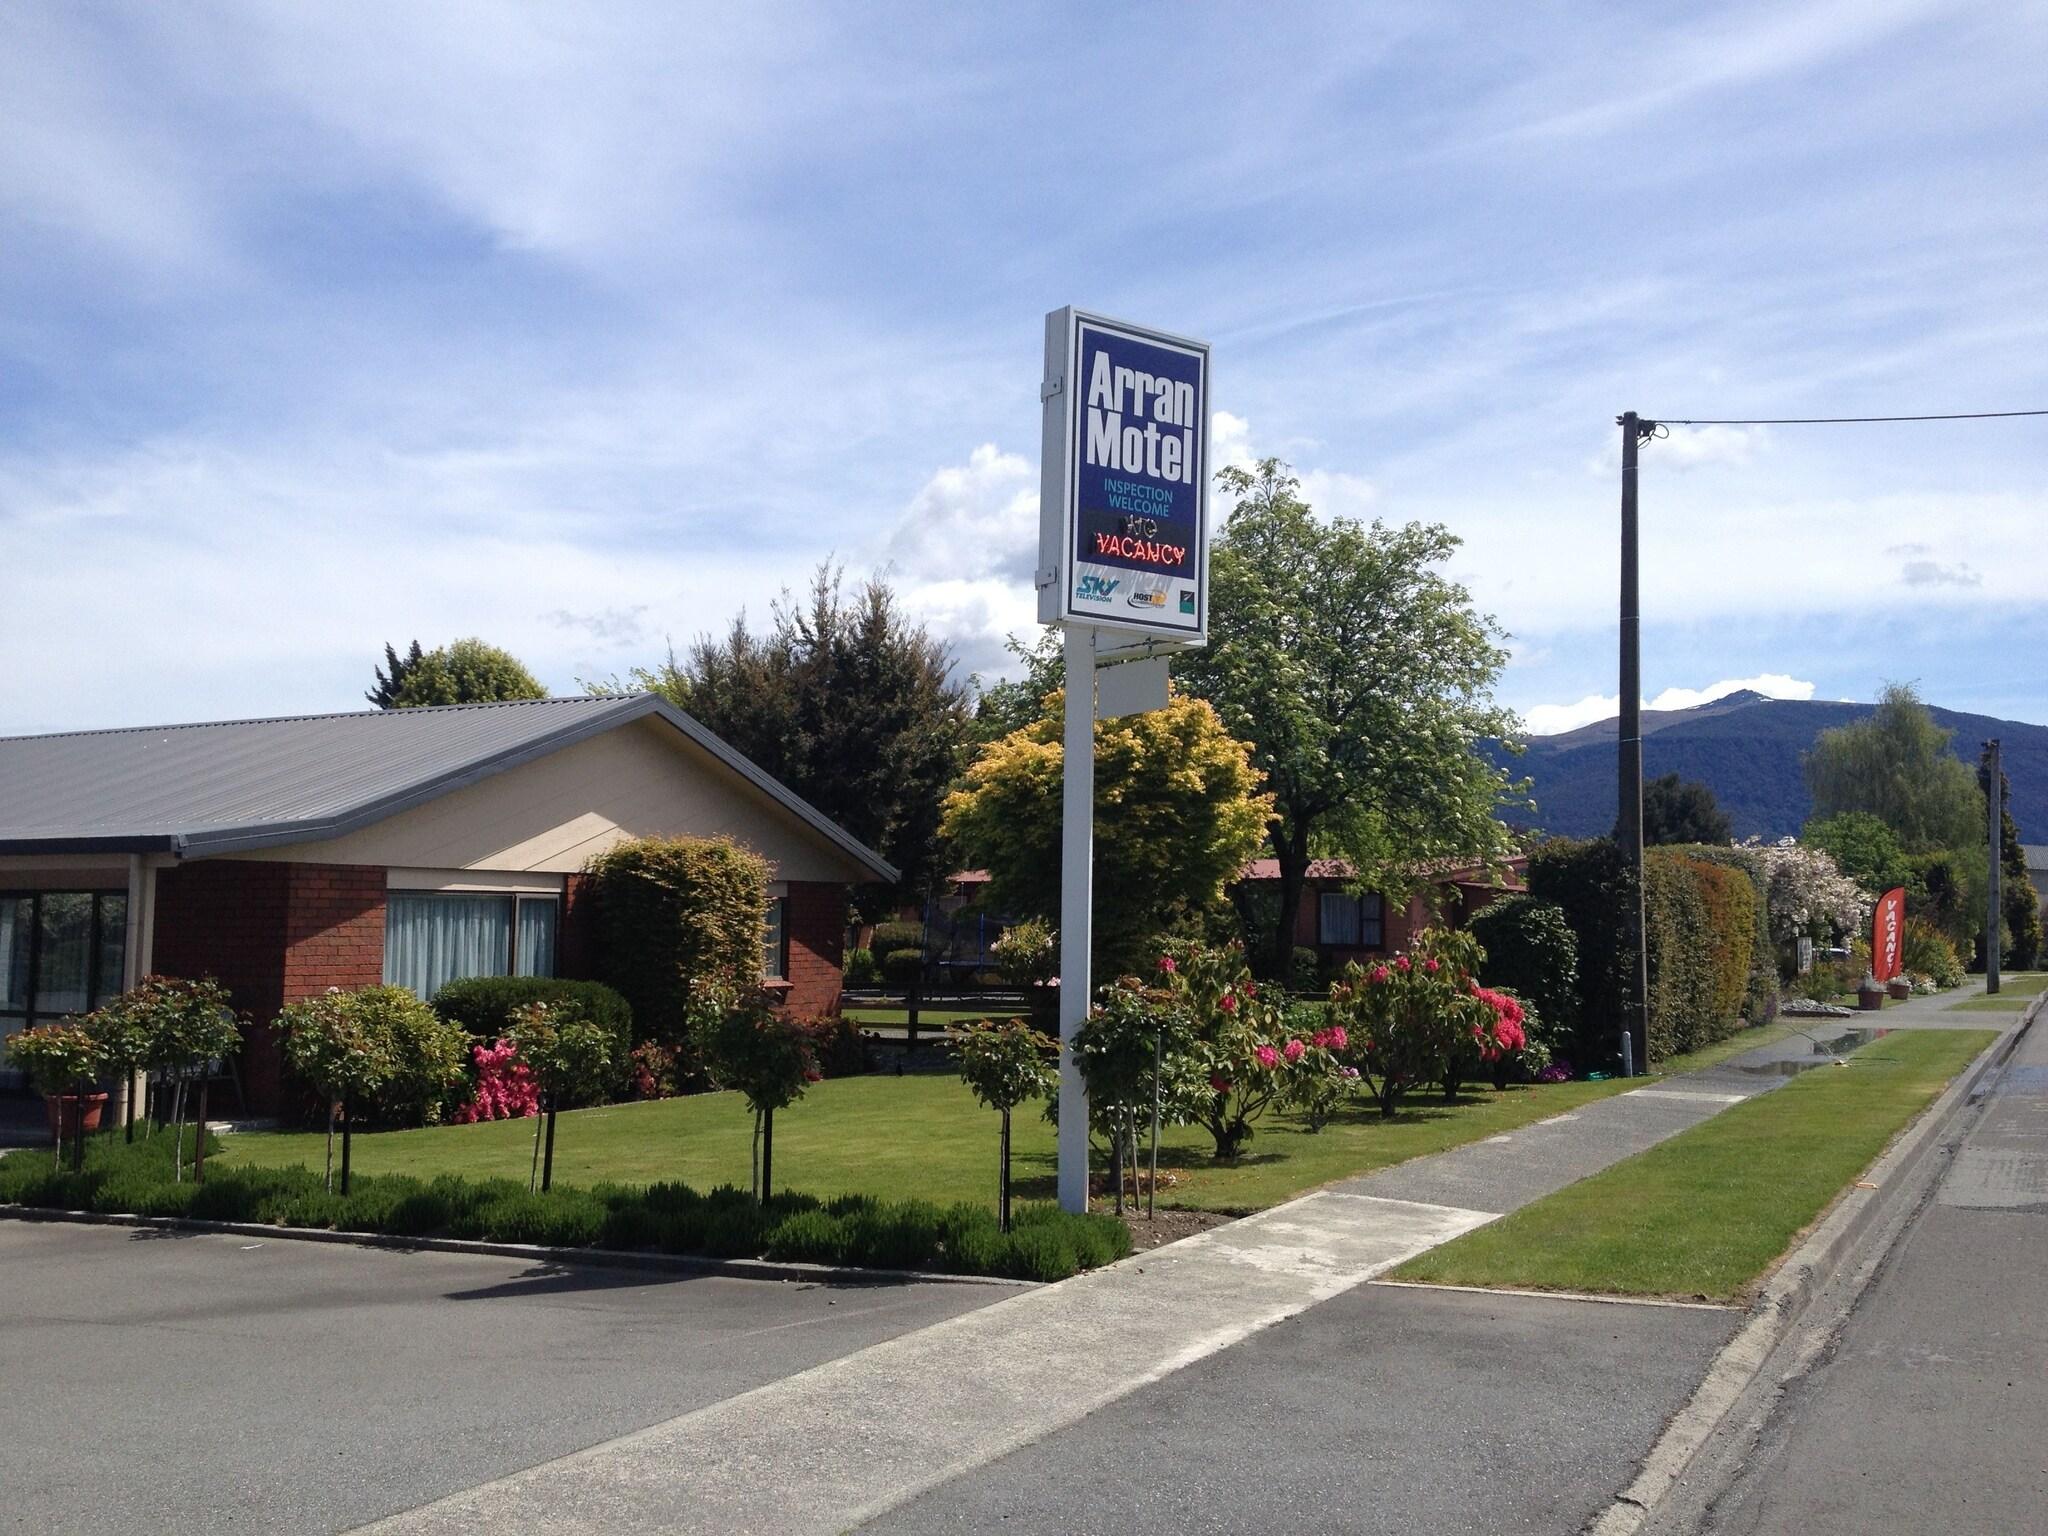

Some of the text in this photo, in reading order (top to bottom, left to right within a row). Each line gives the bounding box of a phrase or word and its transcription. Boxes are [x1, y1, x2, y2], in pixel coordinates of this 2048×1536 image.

[1087, 350, 1194, 428] Arran
[1086, 406, 1193, 484] Motel
[1104, 478, 1173, 503] INSPECTION
[1108, 494, 1169, 517] WELCOME
[1096, 532, 1185, 565] VACANCY
[1075, 592, 1112, 603] TELEVISION
[1076, 575, 1120, 597] SKY
[1133, 592, 1153, 602] HOST
[1886, 900, 1897, 973] VACANCY
